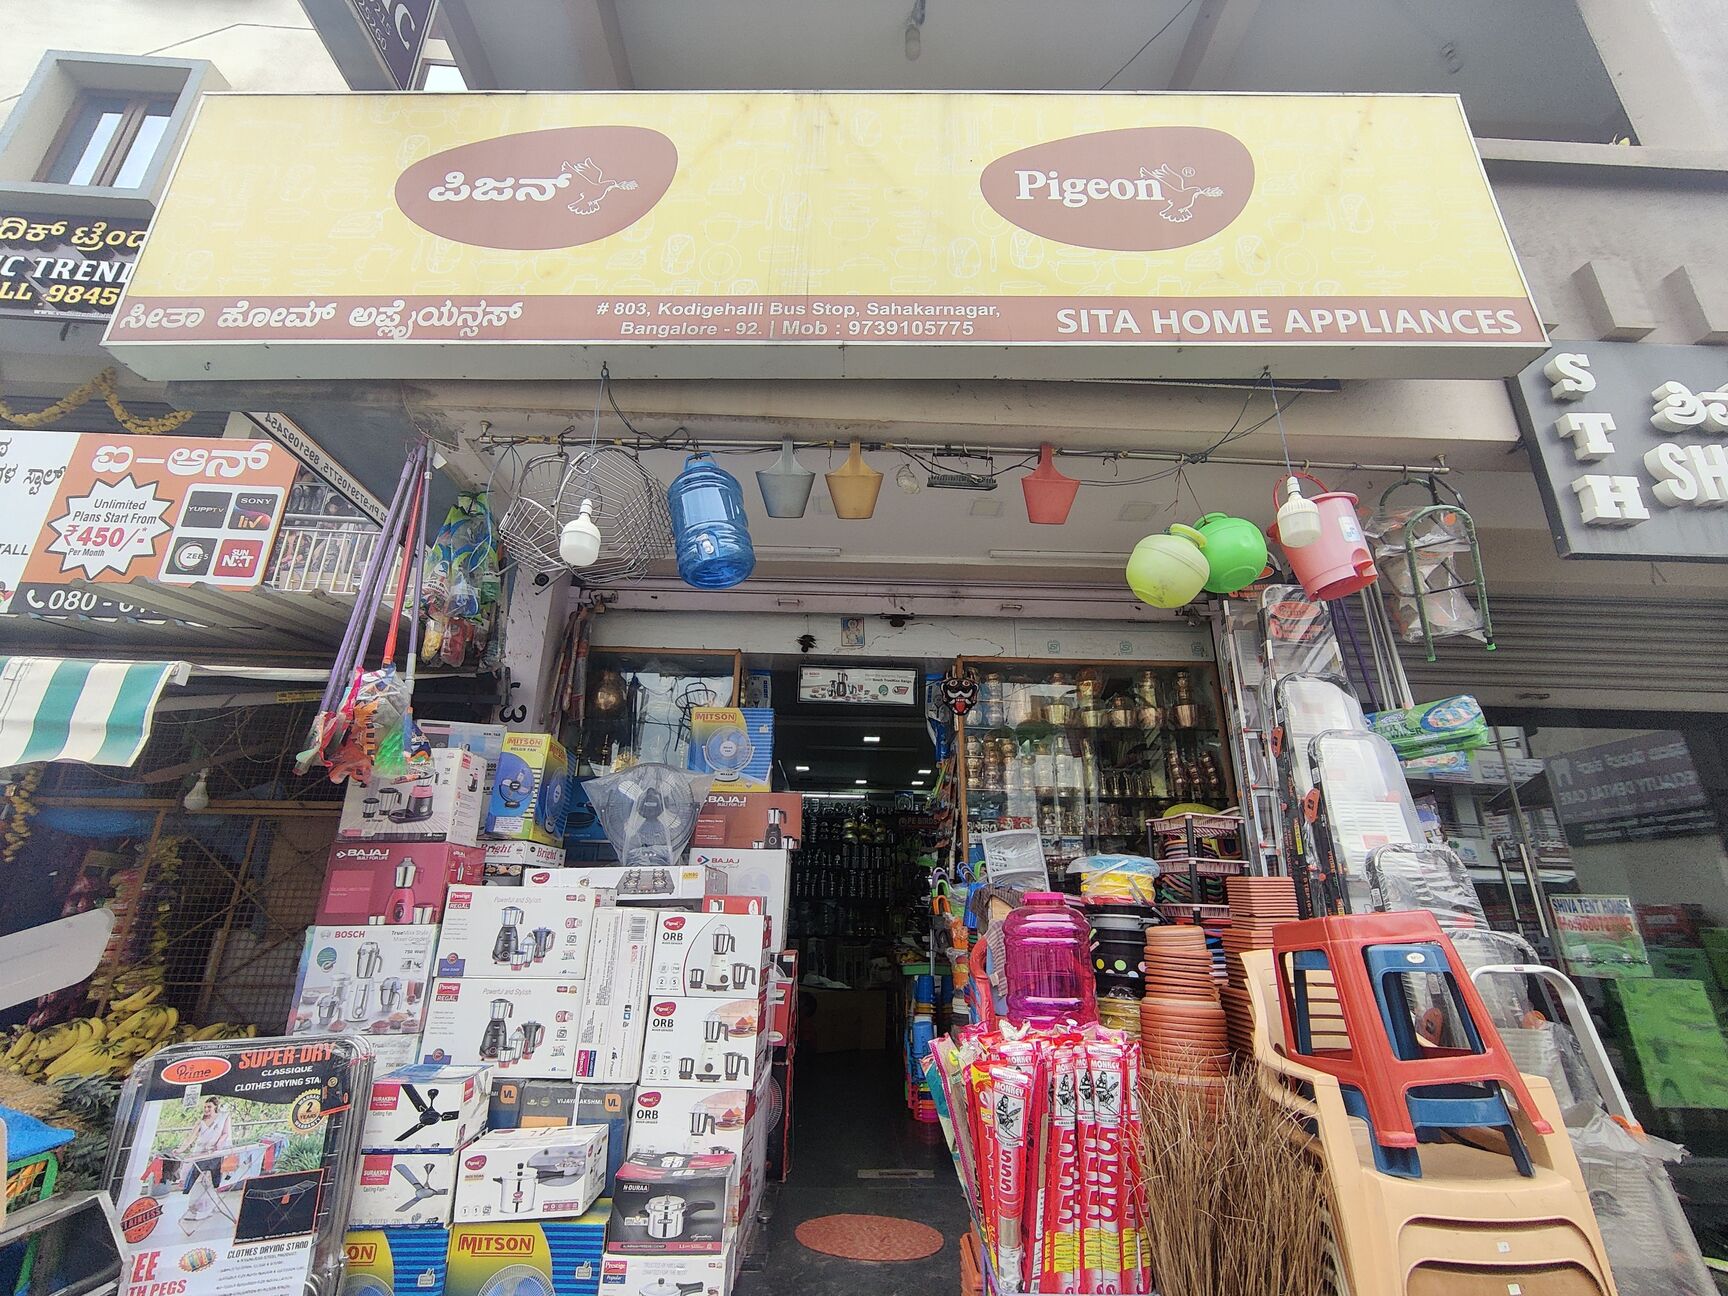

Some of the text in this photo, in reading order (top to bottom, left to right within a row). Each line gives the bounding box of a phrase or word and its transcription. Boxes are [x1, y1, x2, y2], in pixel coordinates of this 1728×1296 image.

[428, 172, 572, 201] ಪಿಜನ್
[1014, 169, 1165, 208] Pigeon
[0, 256, 25, 276] C
[119, 302, 206, 330] ಸೀತಾ
[217, 301, 337, 329] ಹೋಮ್
[613, 302, 652, 317] 803,
[657, 301, 764, 318] Kodigehalli
[769, 302, 806, 316] Bus
[811, 302, 860, 318] Stop,
[866, 301, 1001, 319] Sahakarnagar,
[1056, 309, 1523, 334] SITA HOME APPLIANCES
[620, 321, 718, 338] Bangalore
[735, 322, 763, 336] 92.
[782, 321, 828, 336] Mob
[848, 320, 974, 336] 9739105775
[1644, 443, 1728, 508] SH
[94, 499, 147, 510] Unlimited
[240, 497, 273, 505] SONY
[73, 511, 157, 524] Plans Start From
[68, 548, 105, 557] Per Month
[231, 549, 250, 557] SUN
[696, 713, 735, 721] MITSON
[536, 848, 556, 860] Bright
[335, 930, 365, 939] BOSCH
[663, 932, 683, 941] ORB
[438, 983, 460, 991] Prestige
[653, 1018, 674, 1028] ORB
[239, 1042, 336, 1070] SUPER-DRY
[1091, 1060, 1120, 1069] MONKEY
[176, 1064, 212, 1081] Prime
[261, 1065, 314, 1077] CLASSIQUE
[234, 1077, 322, 1092] CLOTHES DRYING STA
[994, 1081, 1024, 1096] MONKEY
[504, 1090, 514, 1098] VL
[307, 1101, 313, 1113] 2
[299, 1113, 317, 1121] YEARS
[636, 1109, 659, 1120] ORB
[227, 1240, 309, 1259] CLOTHES DRYING STAND
[460, 1236, 533, 1252] MITSON
[606, 1262, 625, 1270] Prestige
[150, 1279, 187, 1296] PEGS
